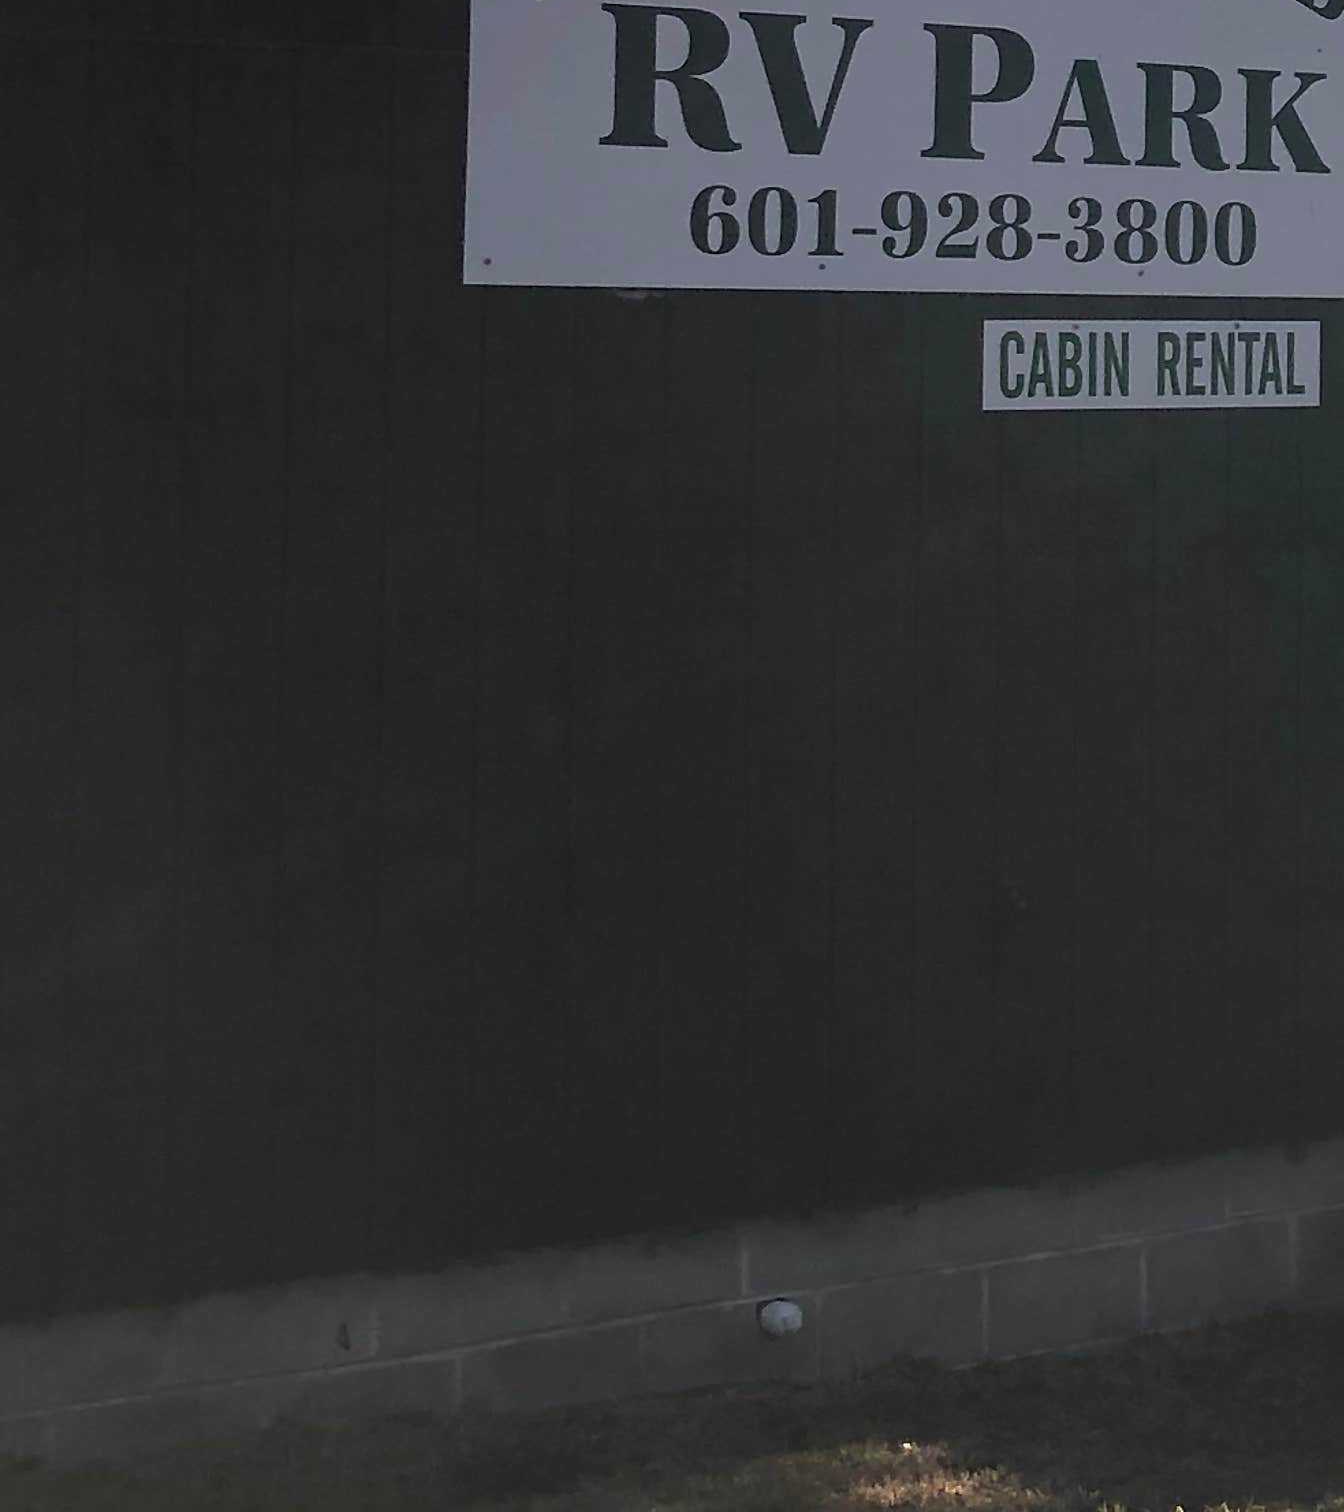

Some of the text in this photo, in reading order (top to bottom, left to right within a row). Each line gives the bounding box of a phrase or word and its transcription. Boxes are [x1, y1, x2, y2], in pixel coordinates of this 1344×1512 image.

[599, 2, 1331, 174] RV PARK
[689, 184, 1257, 266] 601-928-3800
[999, 330, 1306, 399] CABIN RENTAL
